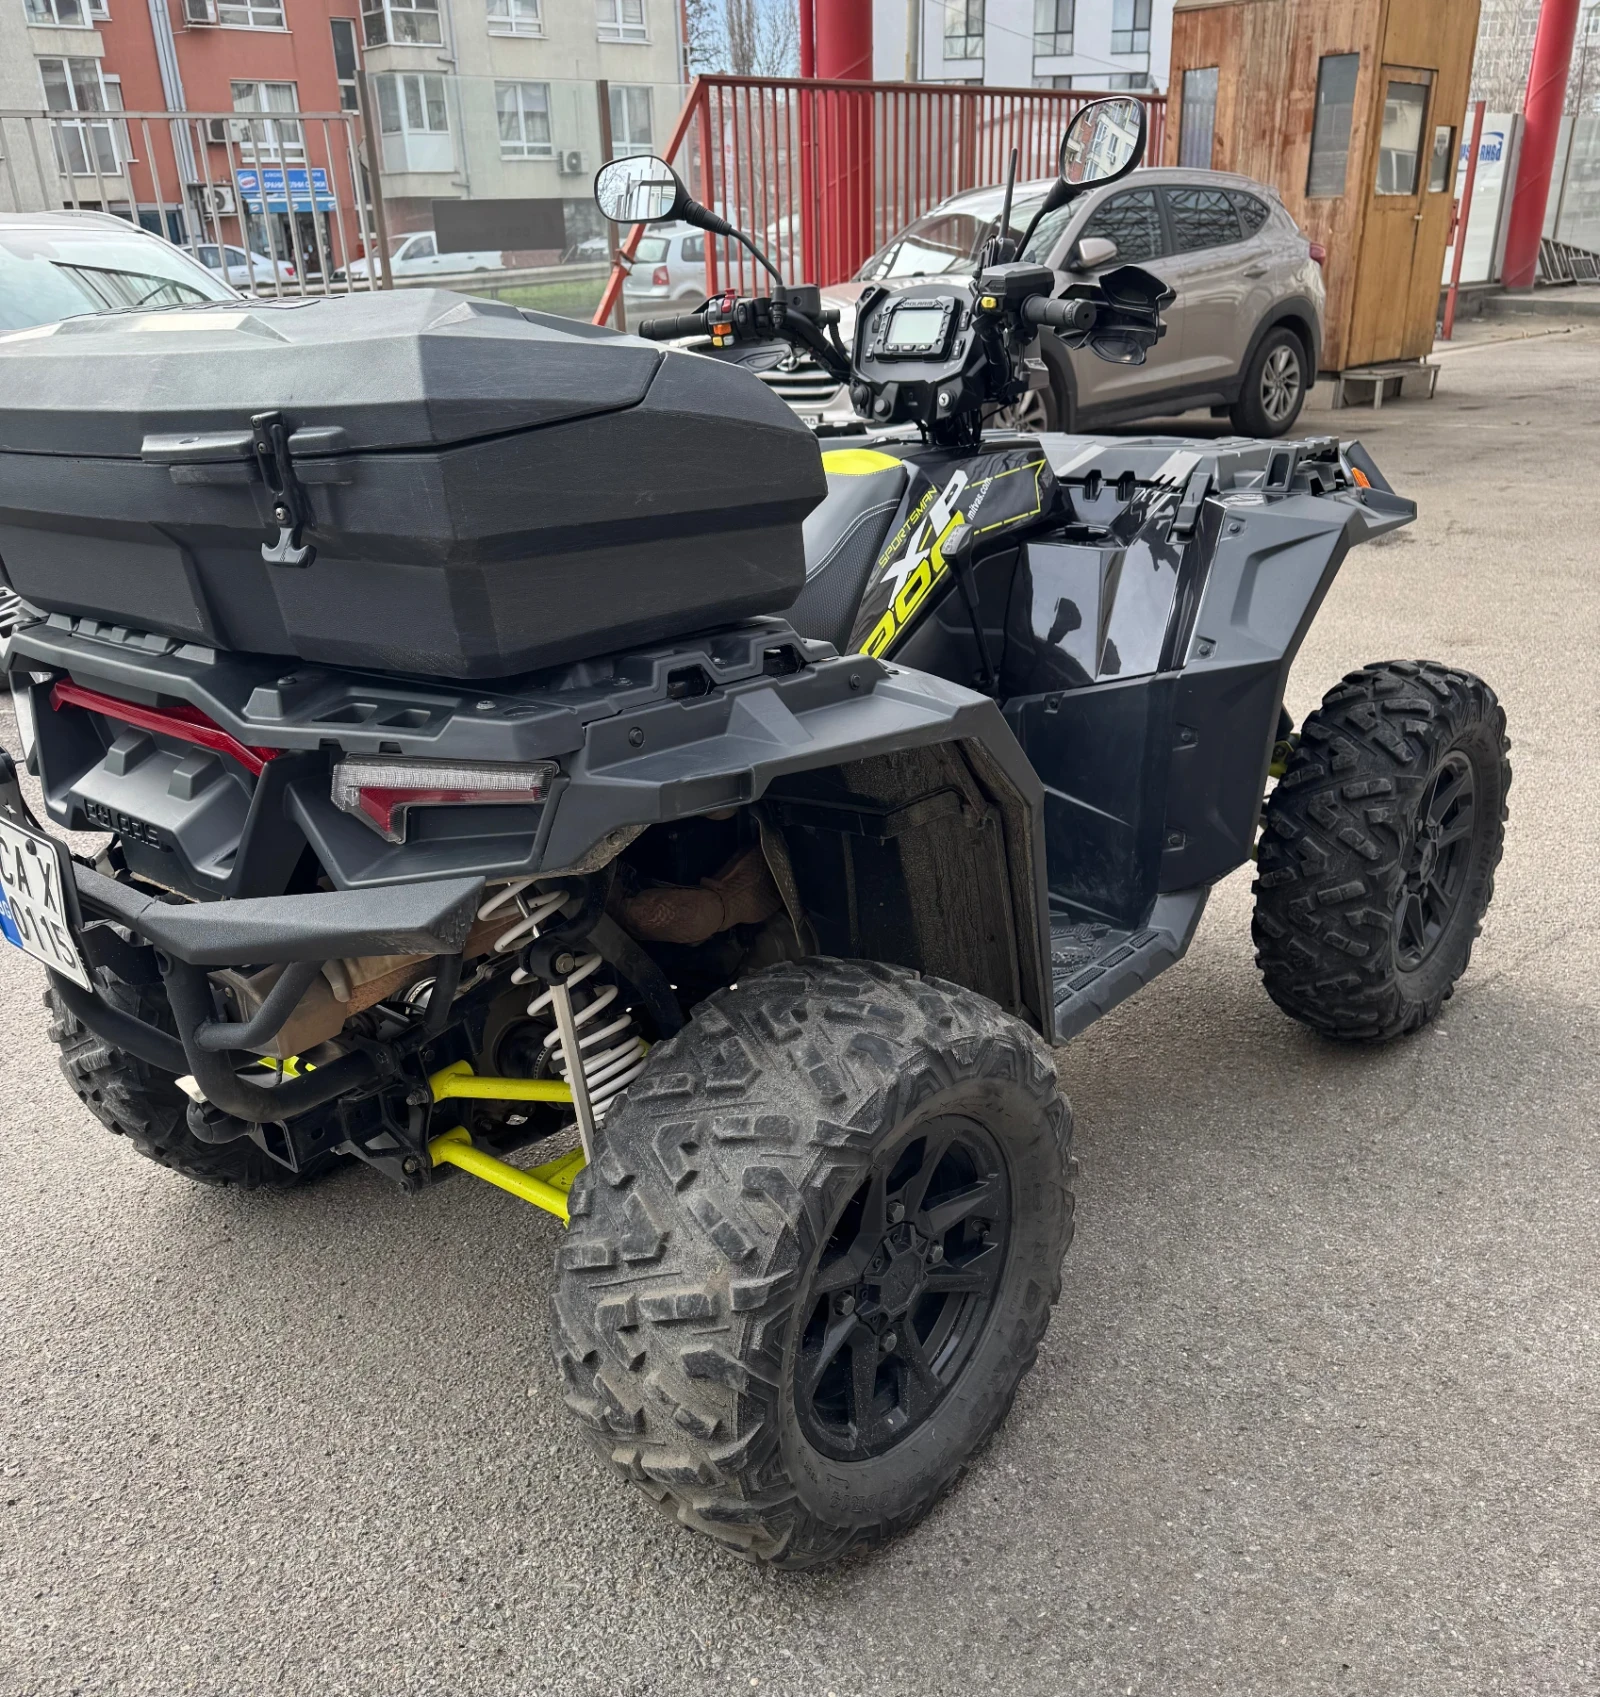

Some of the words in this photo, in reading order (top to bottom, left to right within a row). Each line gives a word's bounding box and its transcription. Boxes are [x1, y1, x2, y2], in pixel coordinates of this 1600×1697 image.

[878, 485, 938, 569] SPORTSMAN
[880, 469, 969, 609] XP
[84, 799, 160, 849] POLARIS
[9, 896, 76, 969] 0115
